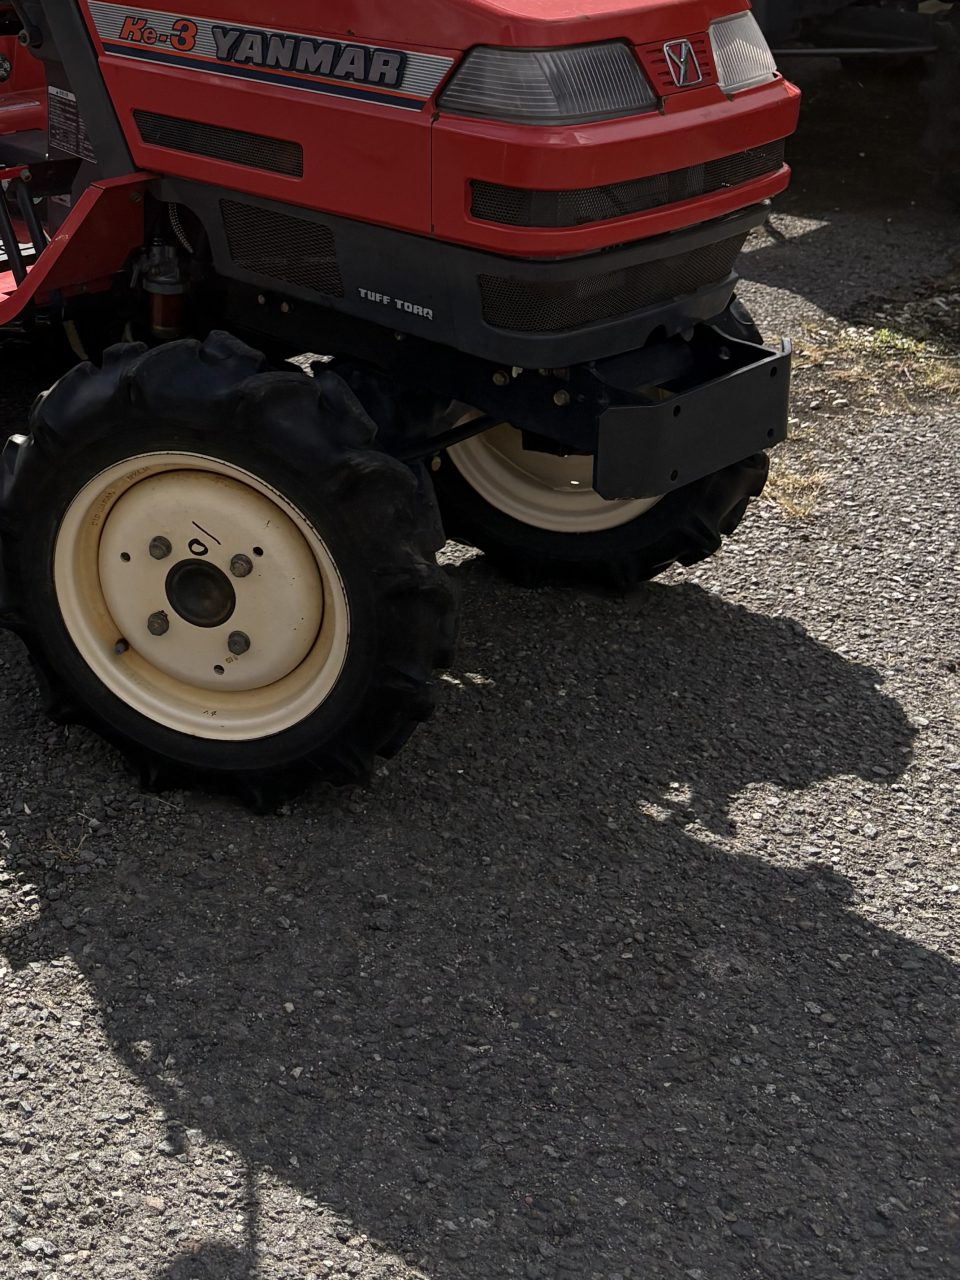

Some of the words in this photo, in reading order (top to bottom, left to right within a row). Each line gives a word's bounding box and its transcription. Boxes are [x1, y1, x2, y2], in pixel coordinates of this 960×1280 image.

[119, 15, 199, 51] Ke-3
[211, 25, 407, 89] YANMAR
[358, 287, 390, 305] TUFF
[394, 298, 433, 321] TORQ
